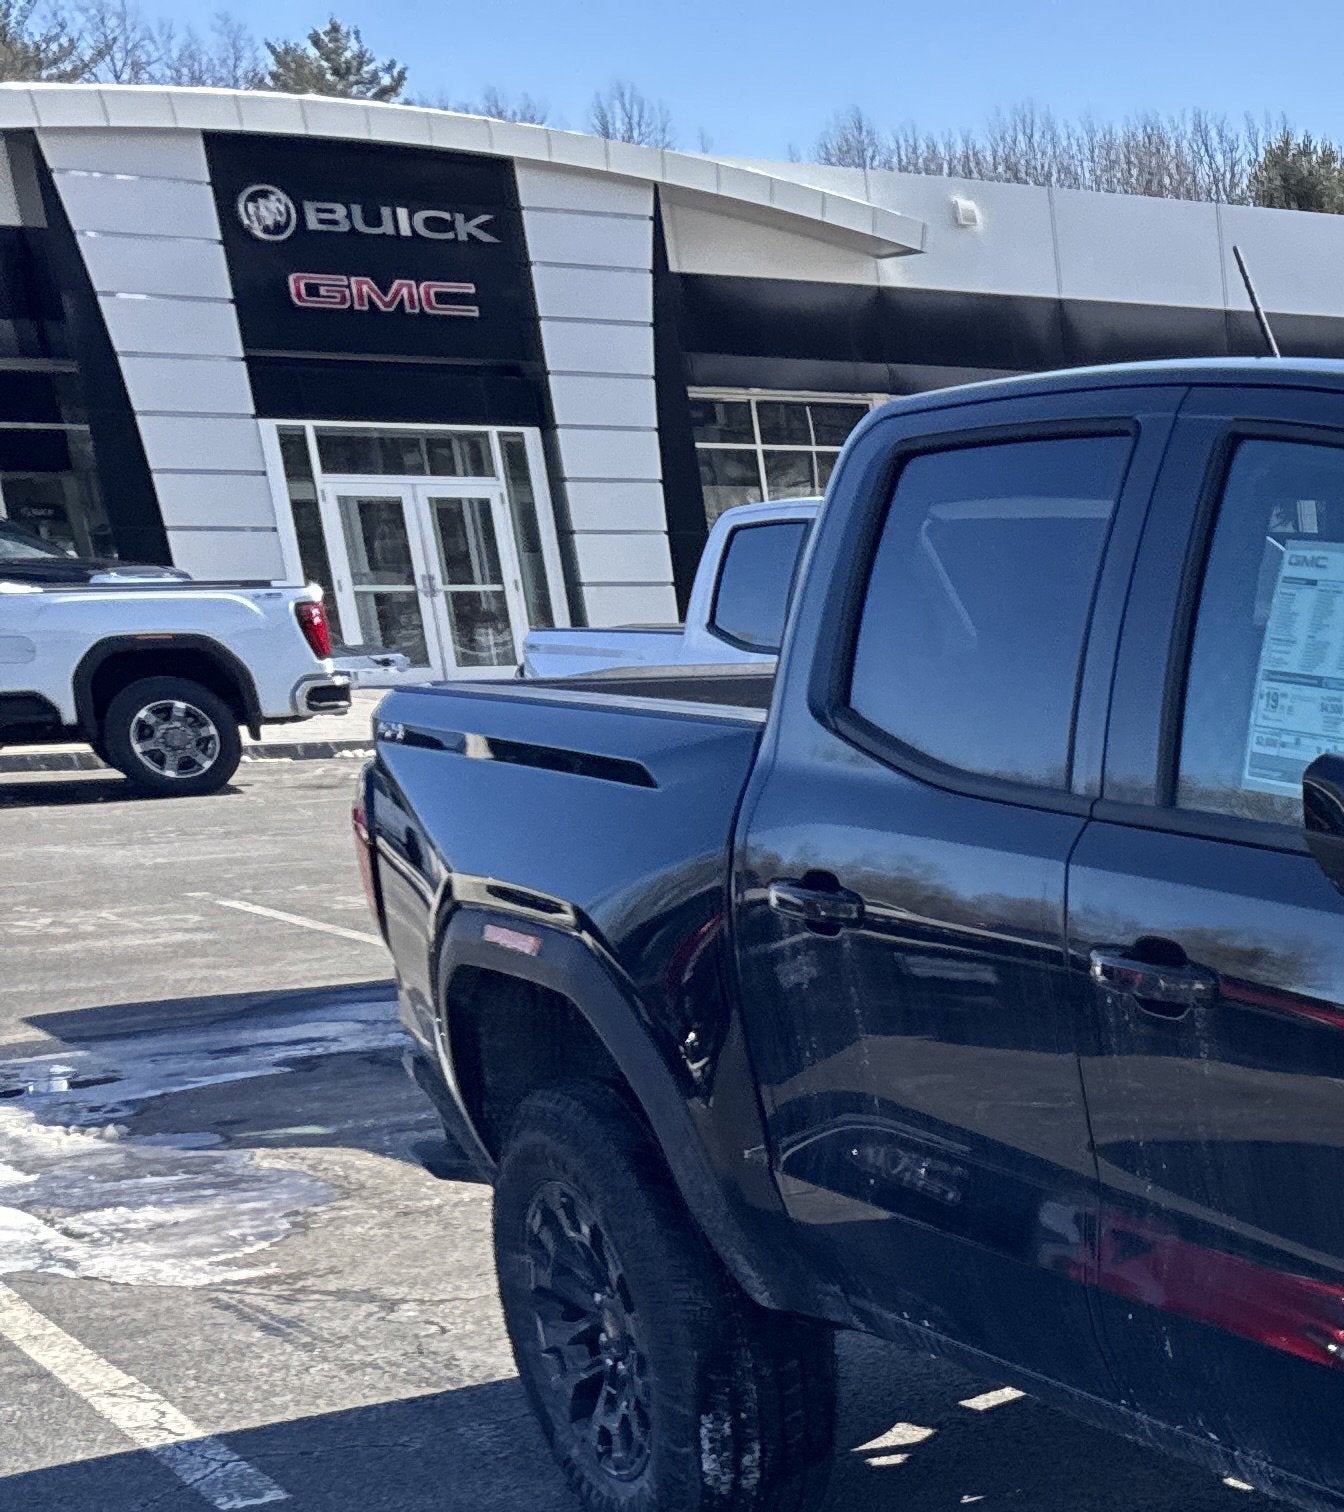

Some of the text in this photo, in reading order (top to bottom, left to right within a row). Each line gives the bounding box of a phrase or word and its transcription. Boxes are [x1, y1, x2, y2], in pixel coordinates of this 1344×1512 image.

[303, 200, 501, 243] BUICK
[288, 272, 480, 317] GMC
[1287, 554, 1328, 569] GMC
